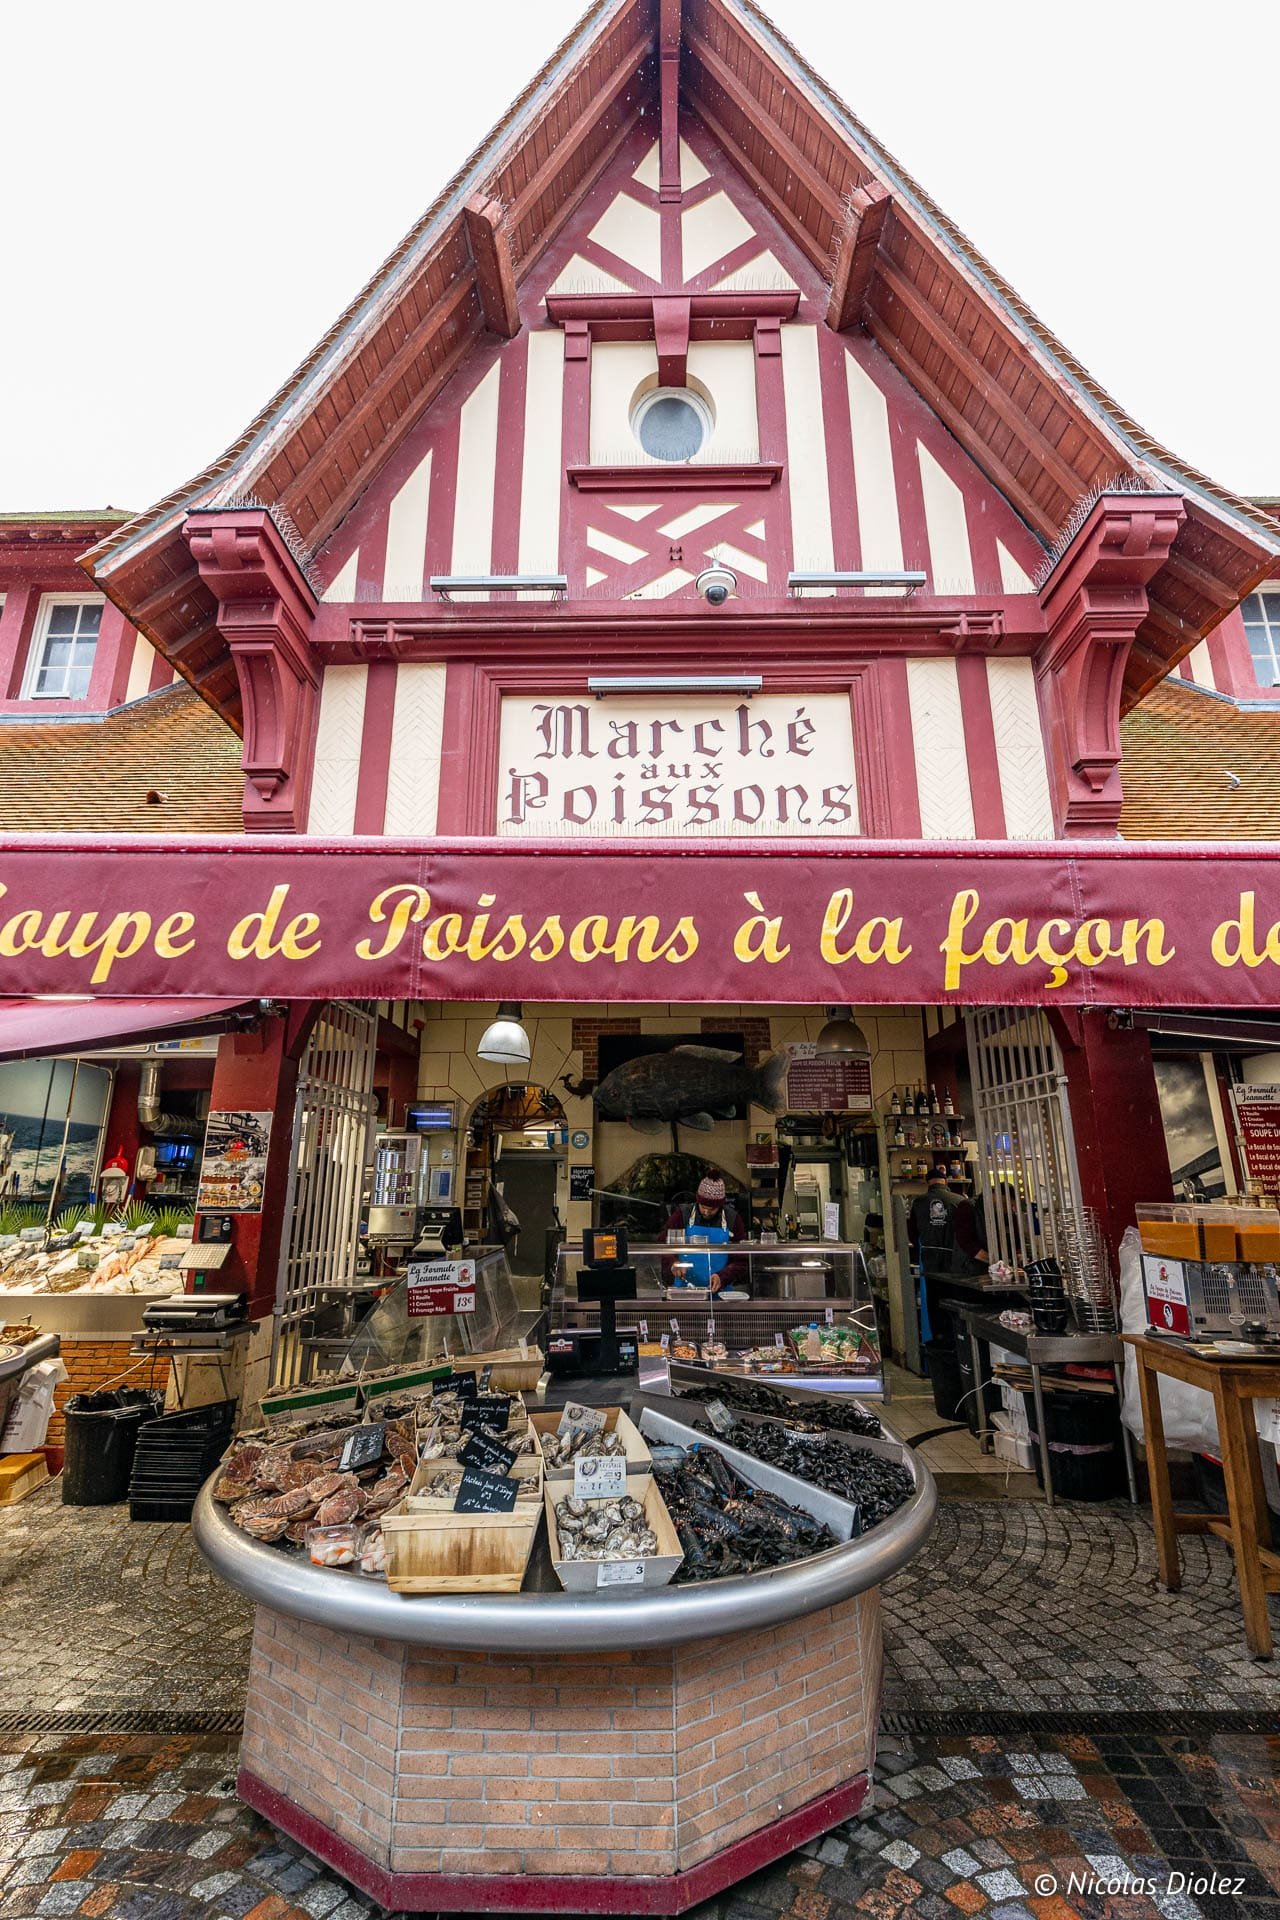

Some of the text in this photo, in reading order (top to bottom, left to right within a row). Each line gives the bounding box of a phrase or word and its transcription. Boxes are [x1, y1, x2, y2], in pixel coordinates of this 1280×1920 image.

[531, 703, 817, 761] Marché
[640, 762, 723, 780] aux
[502, 767, 854, 828] Poissons
[0, 884, 195, 984] oupe
[227, 884, 321, 960] de
[355, 884, 699, 962] Poissons
[733, 891, 790, 964] à
[820, 888, 912, 966] la
[939, 889, 1175, 990] façon
[1236, 1086, 1246, 1094] La
[1242, 1094, 1274, 1103] Jeannette
[1250, 1129, 1273, 1137] SOUPE
[410, 1264, 455, 1274] La Formule
[415, 1274, 450, 1285] Jeannette
[635, 1566, 644, 1575] 3
